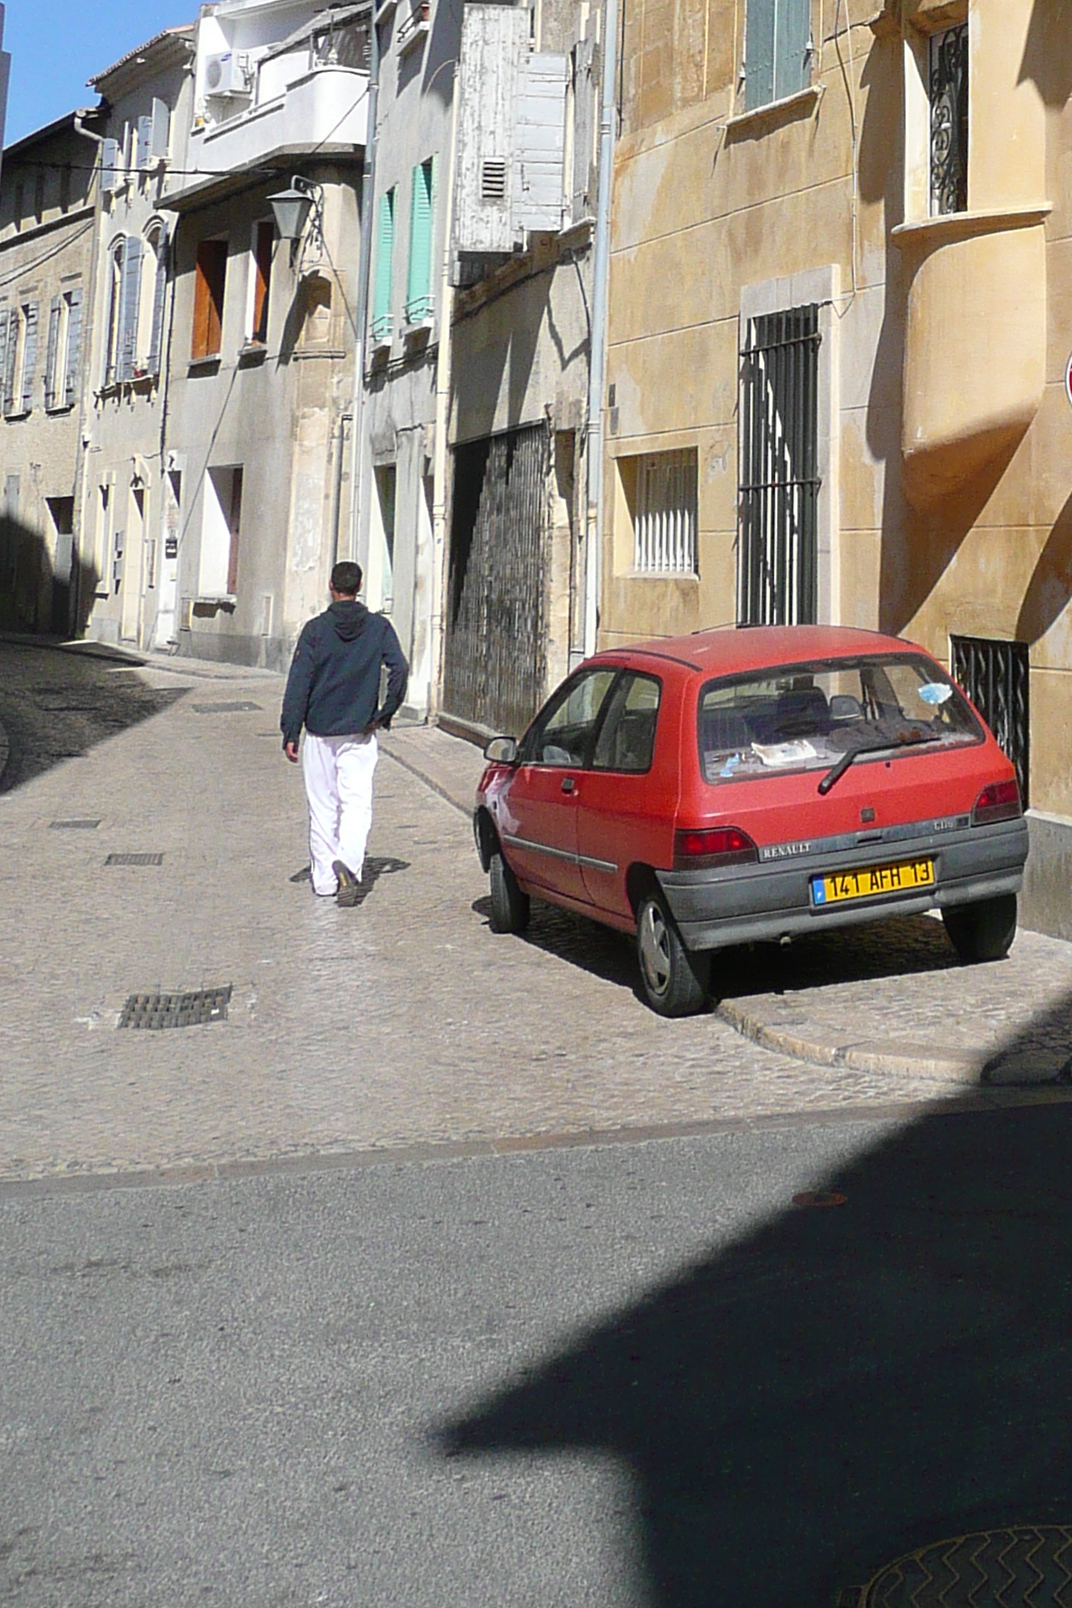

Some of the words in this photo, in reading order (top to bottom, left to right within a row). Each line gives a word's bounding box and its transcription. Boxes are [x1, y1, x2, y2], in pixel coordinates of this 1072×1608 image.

[764, 843, 811, 858] RENAULT
[830, 873, 859, 896] 141
[870, 866, 900, 891] AFH
[910, 861, 929, 882] 13
